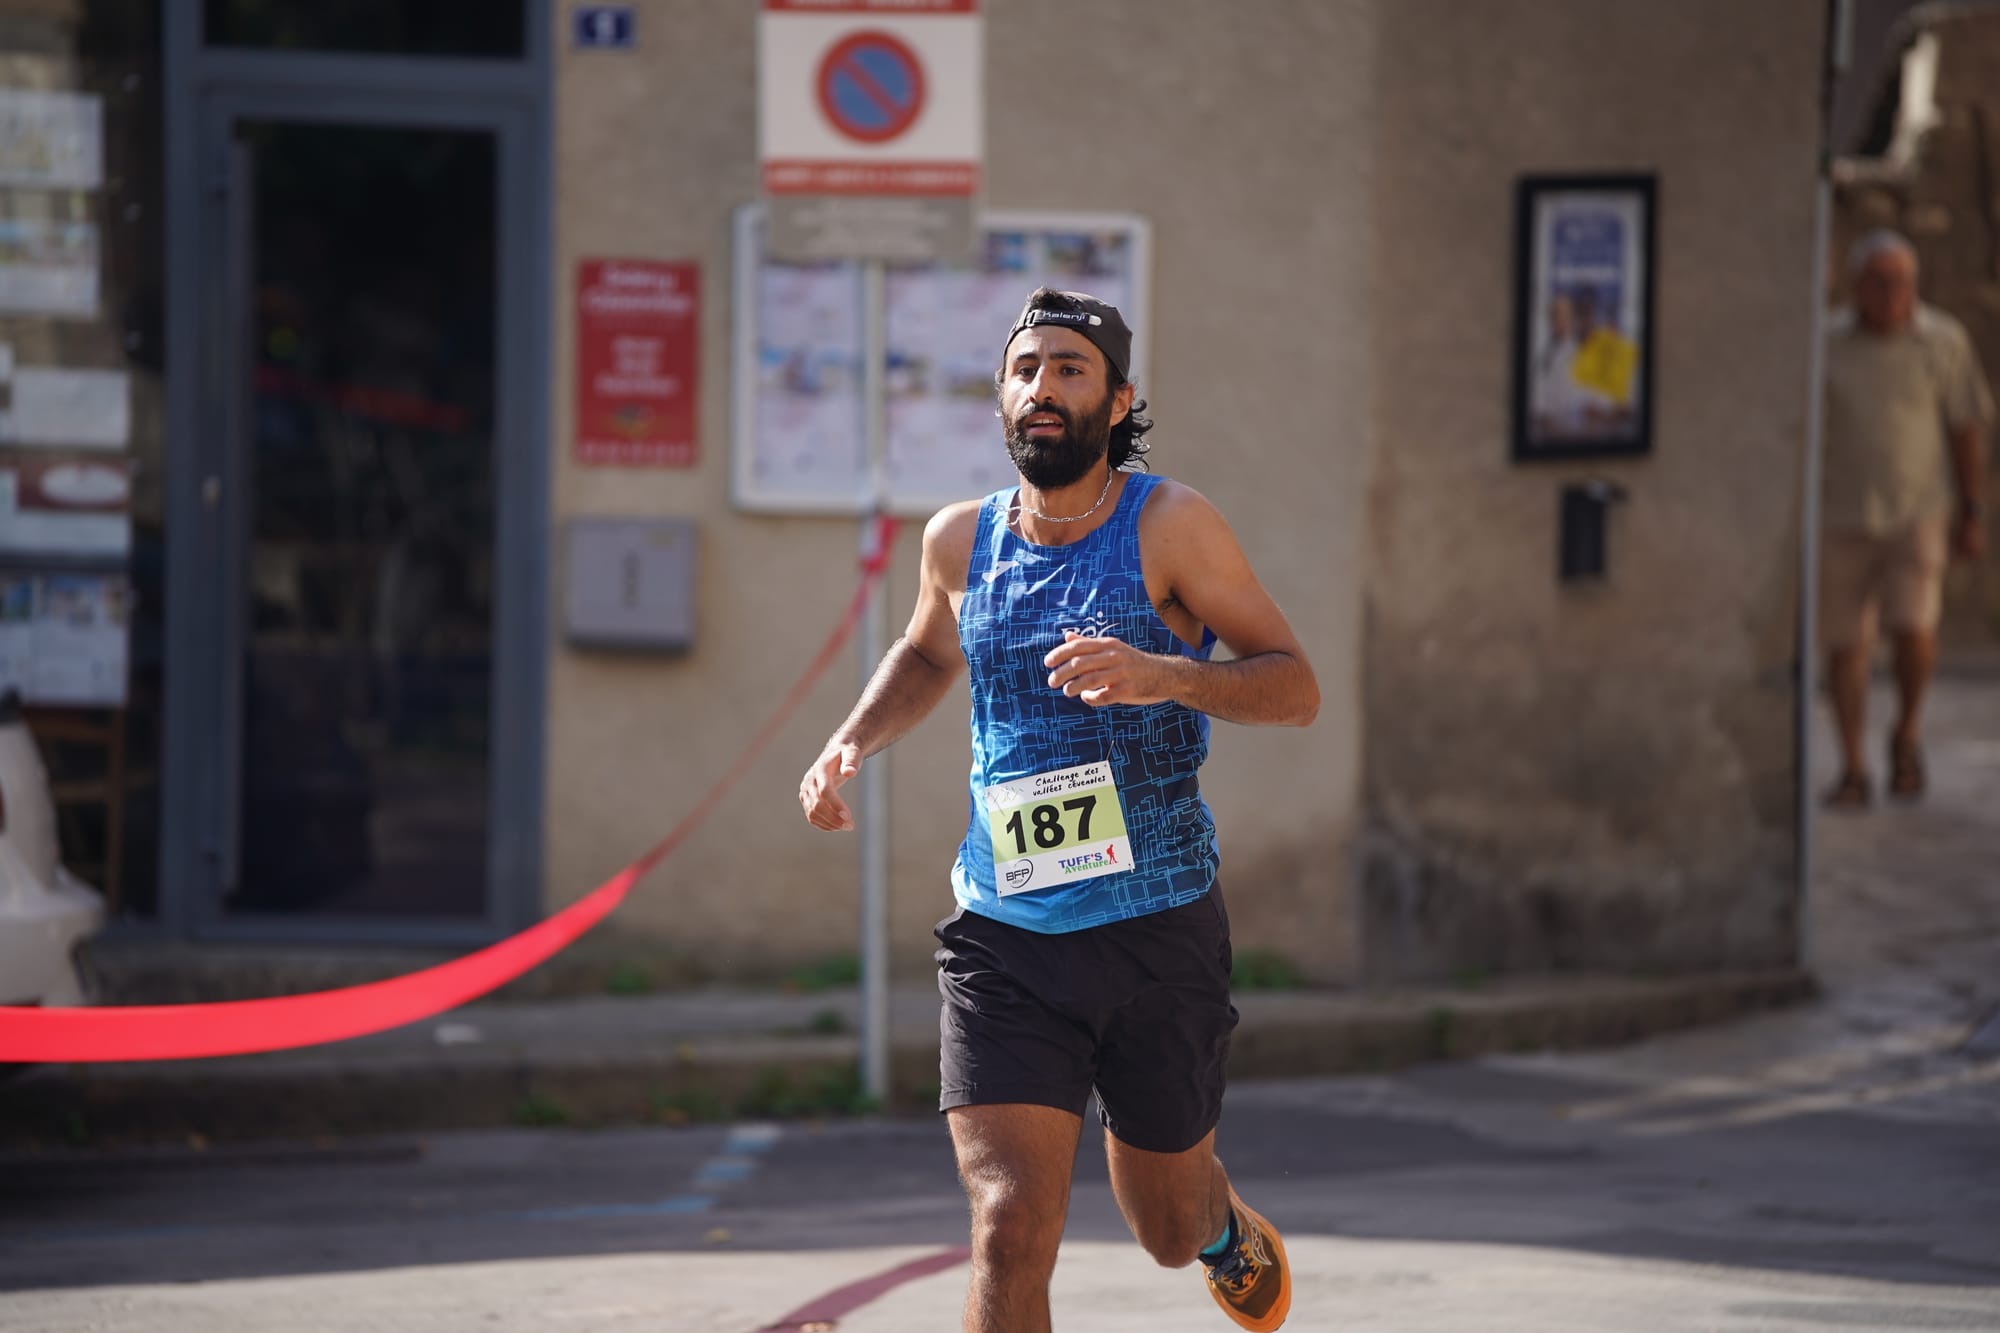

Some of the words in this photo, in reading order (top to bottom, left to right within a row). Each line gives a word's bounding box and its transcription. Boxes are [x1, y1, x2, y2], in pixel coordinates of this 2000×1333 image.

[1043, 311, 1086, 321] Kalenji
[1036, 772, 1079, 786] Challenge
[1006, 795, 1096, 854] 187
[1058, 852, 1102, 869] TUFF'S
[1064, 860, 1108, 874] Aventure
[1006, 868, 1029, 881] BFP
